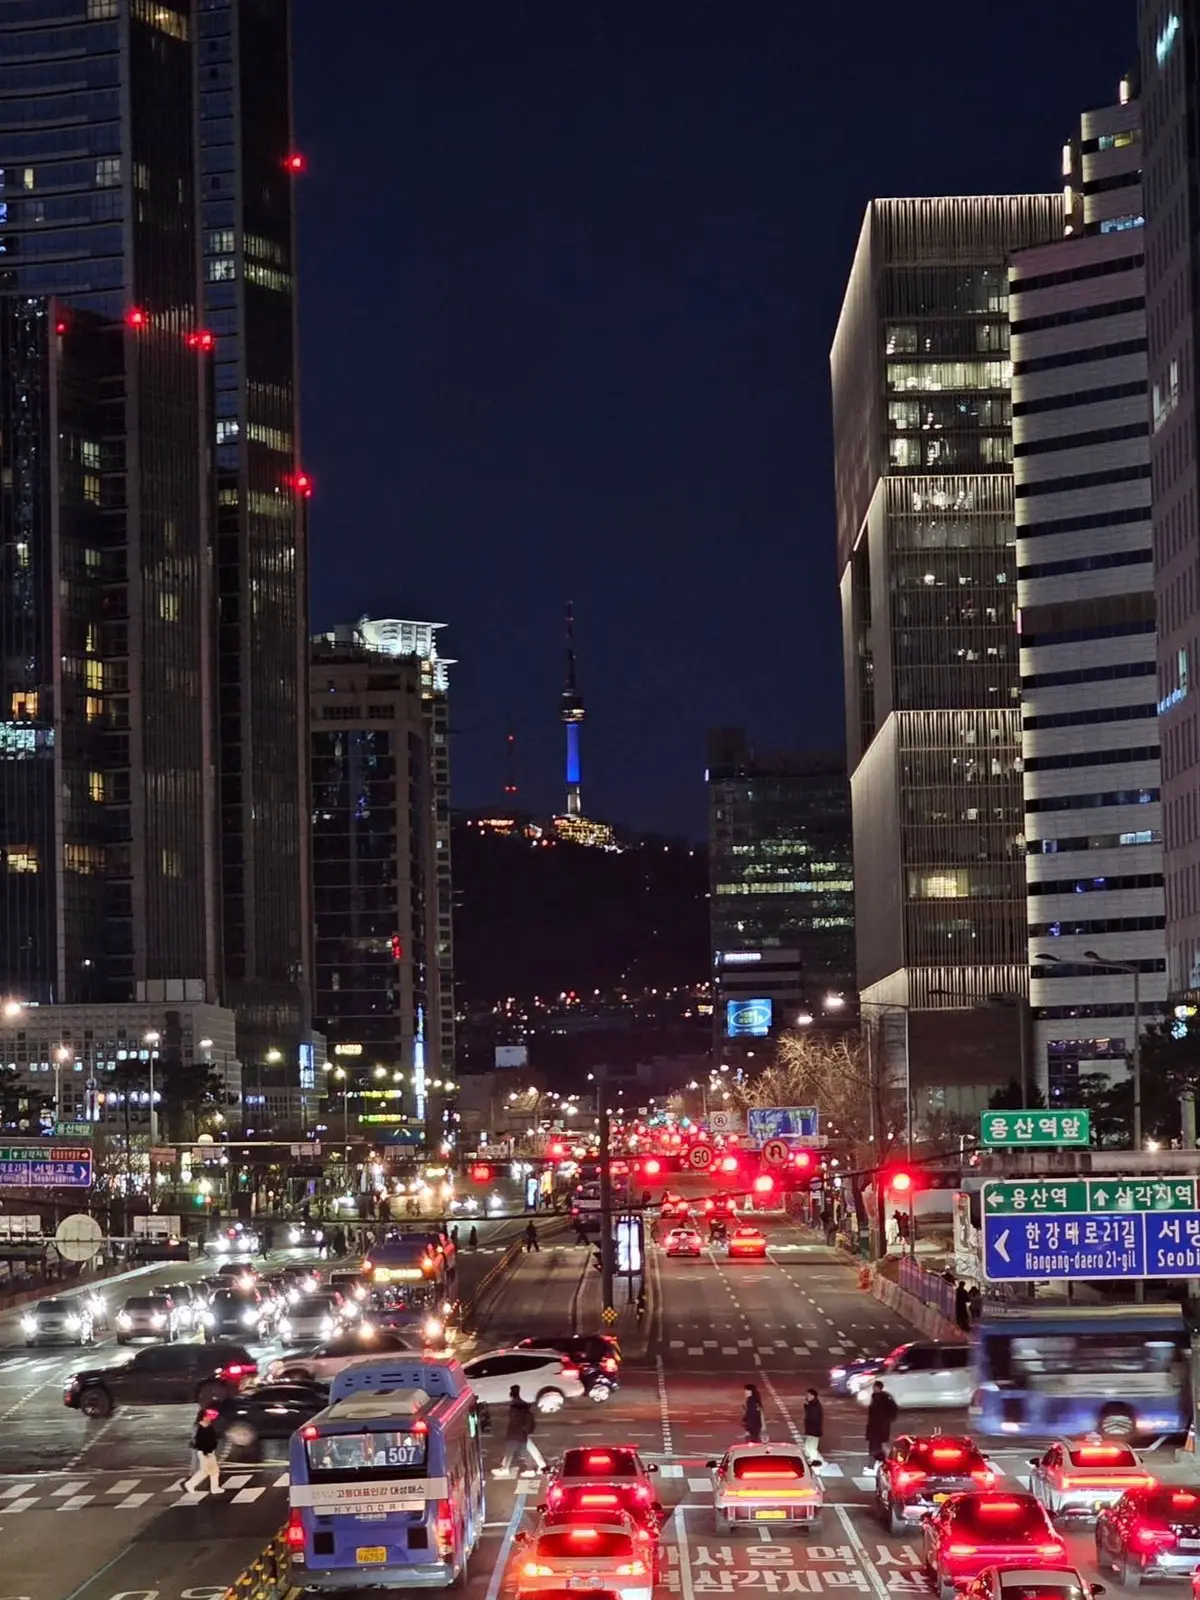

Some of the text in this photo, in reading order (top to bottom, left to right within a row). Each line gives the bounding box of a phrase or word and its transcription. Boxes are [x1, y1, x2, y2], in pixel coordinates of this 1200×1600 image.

[989, 1116, 1081, 1139] 용산역앞
[694, 1150, 709, 1164] 50
[1011, 1187, 1068, 1209] 용산역
[1115, 1185, 1192, 1206] 삼각지역
[1025, 1220, 1136, 1250] 한강대로21길
[1025, 1251, 1103, 1273] Hangang-daero
[388, 1447, 416, 1463] 507
[334, 1502, 405, 1513] HYUNDAI
[693, 1570, 873, 1593] 삼각지역
